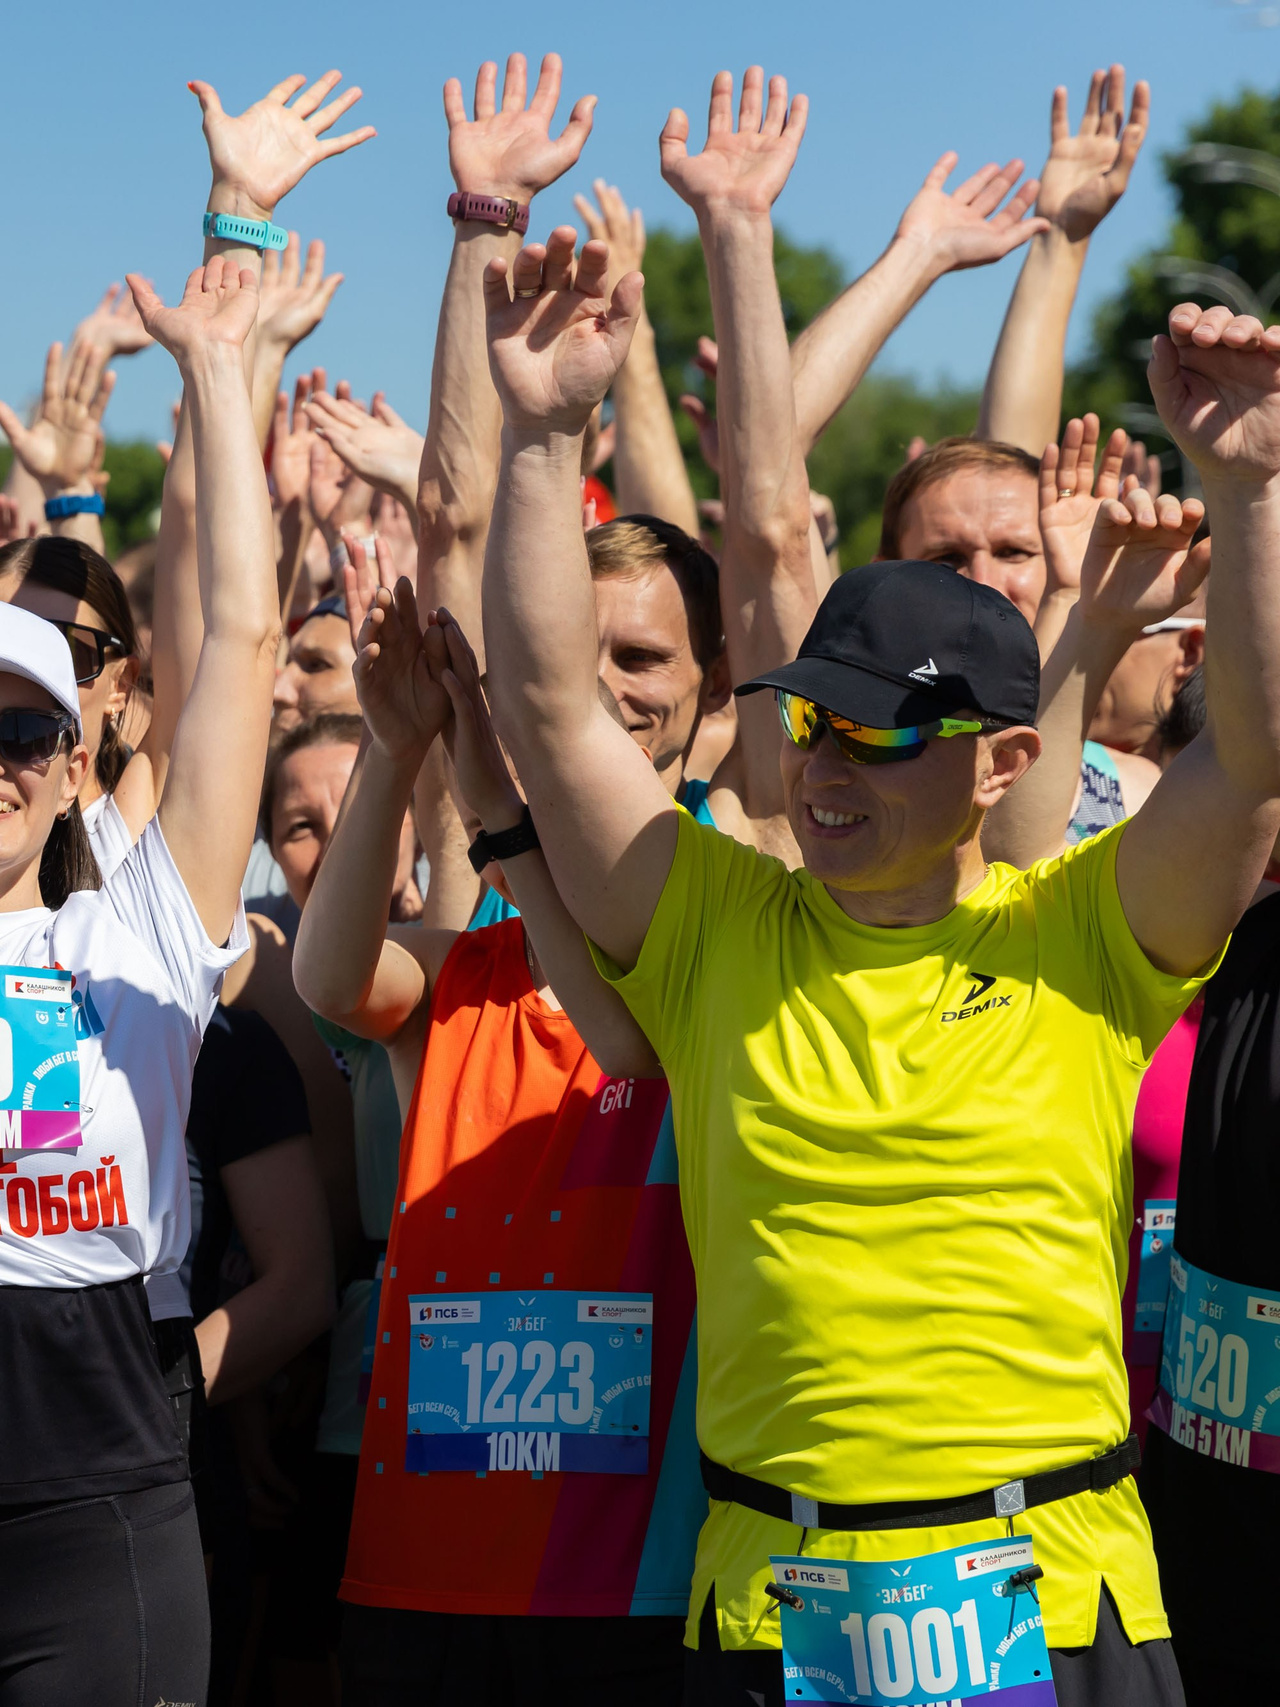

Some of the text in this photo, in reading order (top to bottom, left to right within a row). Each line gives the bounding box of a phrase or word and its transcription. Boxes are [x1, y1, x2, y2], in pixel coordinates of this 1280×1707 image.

[908, 672, 936, 686] DEMIX
[26, 983, 65, 992] КАЛАШНИКОВ
[941, 995, 1013, 1022] DEMIX
[32, 1058, 54, 1080] ЛЮБИ
[51, 1052, 65, 1066] БЕГ
[65, 1051, 72, 1062] В
[72, 1050, 79, 1061] С
[435, 1308, 458, 1318] ПСБ
[1176, 1313, 1249, 1418] 520
[461, 1340, 595, 1424] 1223
[622, 1377, 635, 1390] БЕГ
[637, 1376, 643, 1386] В
[408, 1402, 424, 1414] БЕГУ
[425, 1402, 444, 1412] ВСЕМ
[1170, 1401, 1197, 1450] ПСБ
[1198, 1415, 1213, 1456] 5
[980, 1548, 1026, 1562] КАЛАШНИКОВ
[980, 1559, 1001, 1567] СПОРТ
[800, 1571, 825, 1583] ПСБ
[1014, 1621, 1027, 1638] БЕГ
[1027, 1618, 1035, 1629] В
[1035, 1615, 1043, 1627] С
[840, 1598, 987, 1698] 1001
[784, 1666, 803, 1678] БЕГУ
[805, 1666, 825, 1679] ВСЕМ
